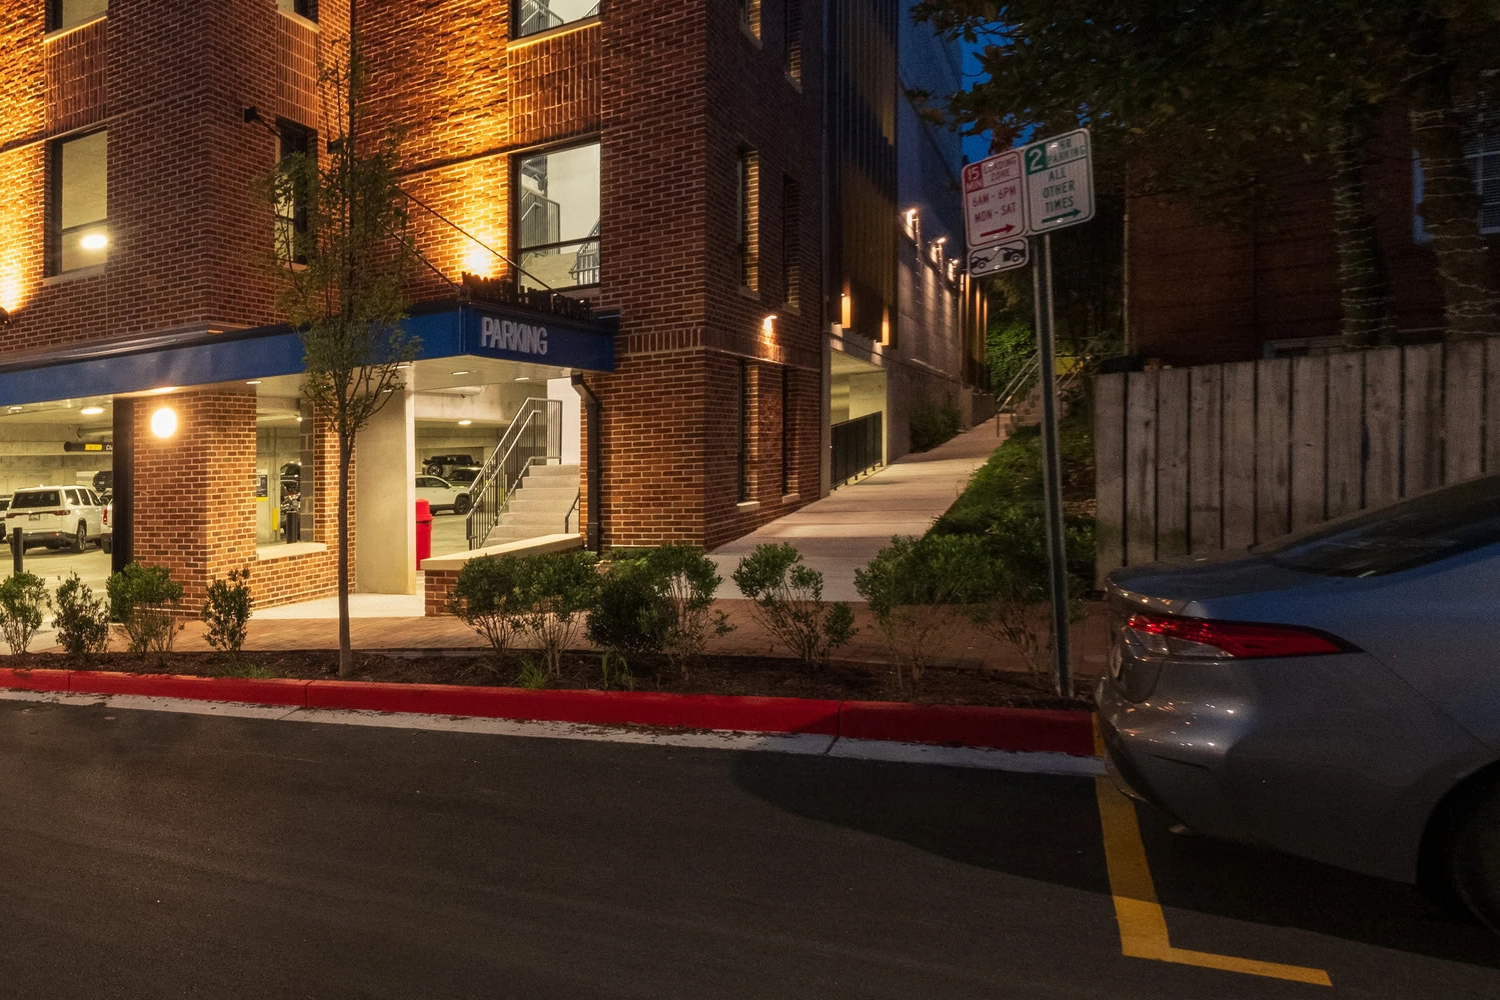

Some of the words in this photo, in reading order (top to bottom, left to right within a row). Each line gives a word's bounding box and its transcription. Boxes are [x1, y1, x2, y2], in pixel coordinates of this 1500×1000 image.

[1029, 149, 1044, 171] 2
[1047, 145, 1086, 164] PARKING
[967, 166, 980, 181] 15
[984, 157, 1017, 173] LOADING
[991, 168, 1011, 181] ZONE
[1048, 167, 1067, 181] ALL
[972, 193, 989, 207] 6AM
[998, 185, 1016, 200] 6PM
[1043, 181, 1075, 198] OTHER
[974, 209, 992, 223] MON
[1000, 202, 1016, 216] SAT
[1045, 196, 1074, 212] TIMES
[481, 317, 548, 355] PARKING
